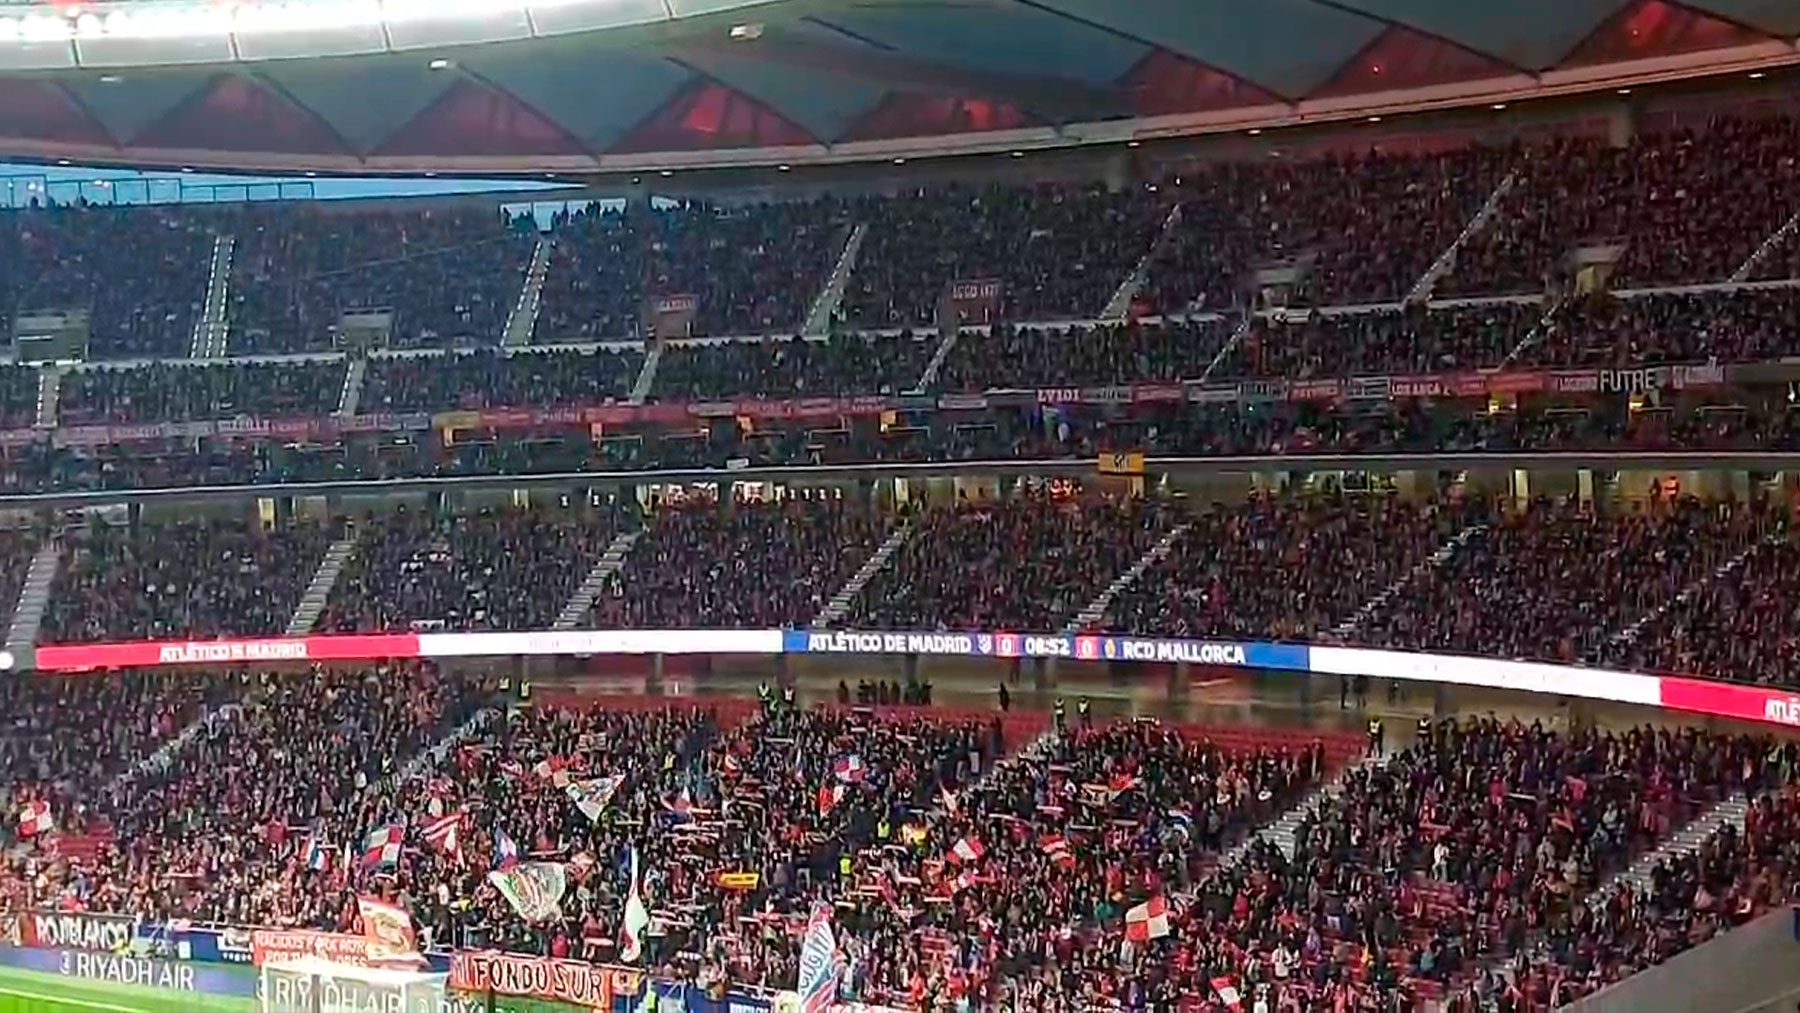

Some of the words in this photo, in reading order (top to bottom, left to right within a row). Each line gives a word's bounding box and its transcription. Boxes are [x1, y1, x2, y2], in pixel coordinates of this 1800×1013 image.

[1600, 367, 1655, 392] FUTRE
[808, 631, 882, 652] ATLÉTICO
[884, 633, 907, 652] DE
[909, 633, 971, 653] MADRID
[1122, 640, 1157, 660] RCD
[1158, 642, 1246, 665] MALLORCA
[77, 952, 153, 986] RIYADH
[159, 960, 195, 991] AIR
[552, 962, 606, 1005] SUR
